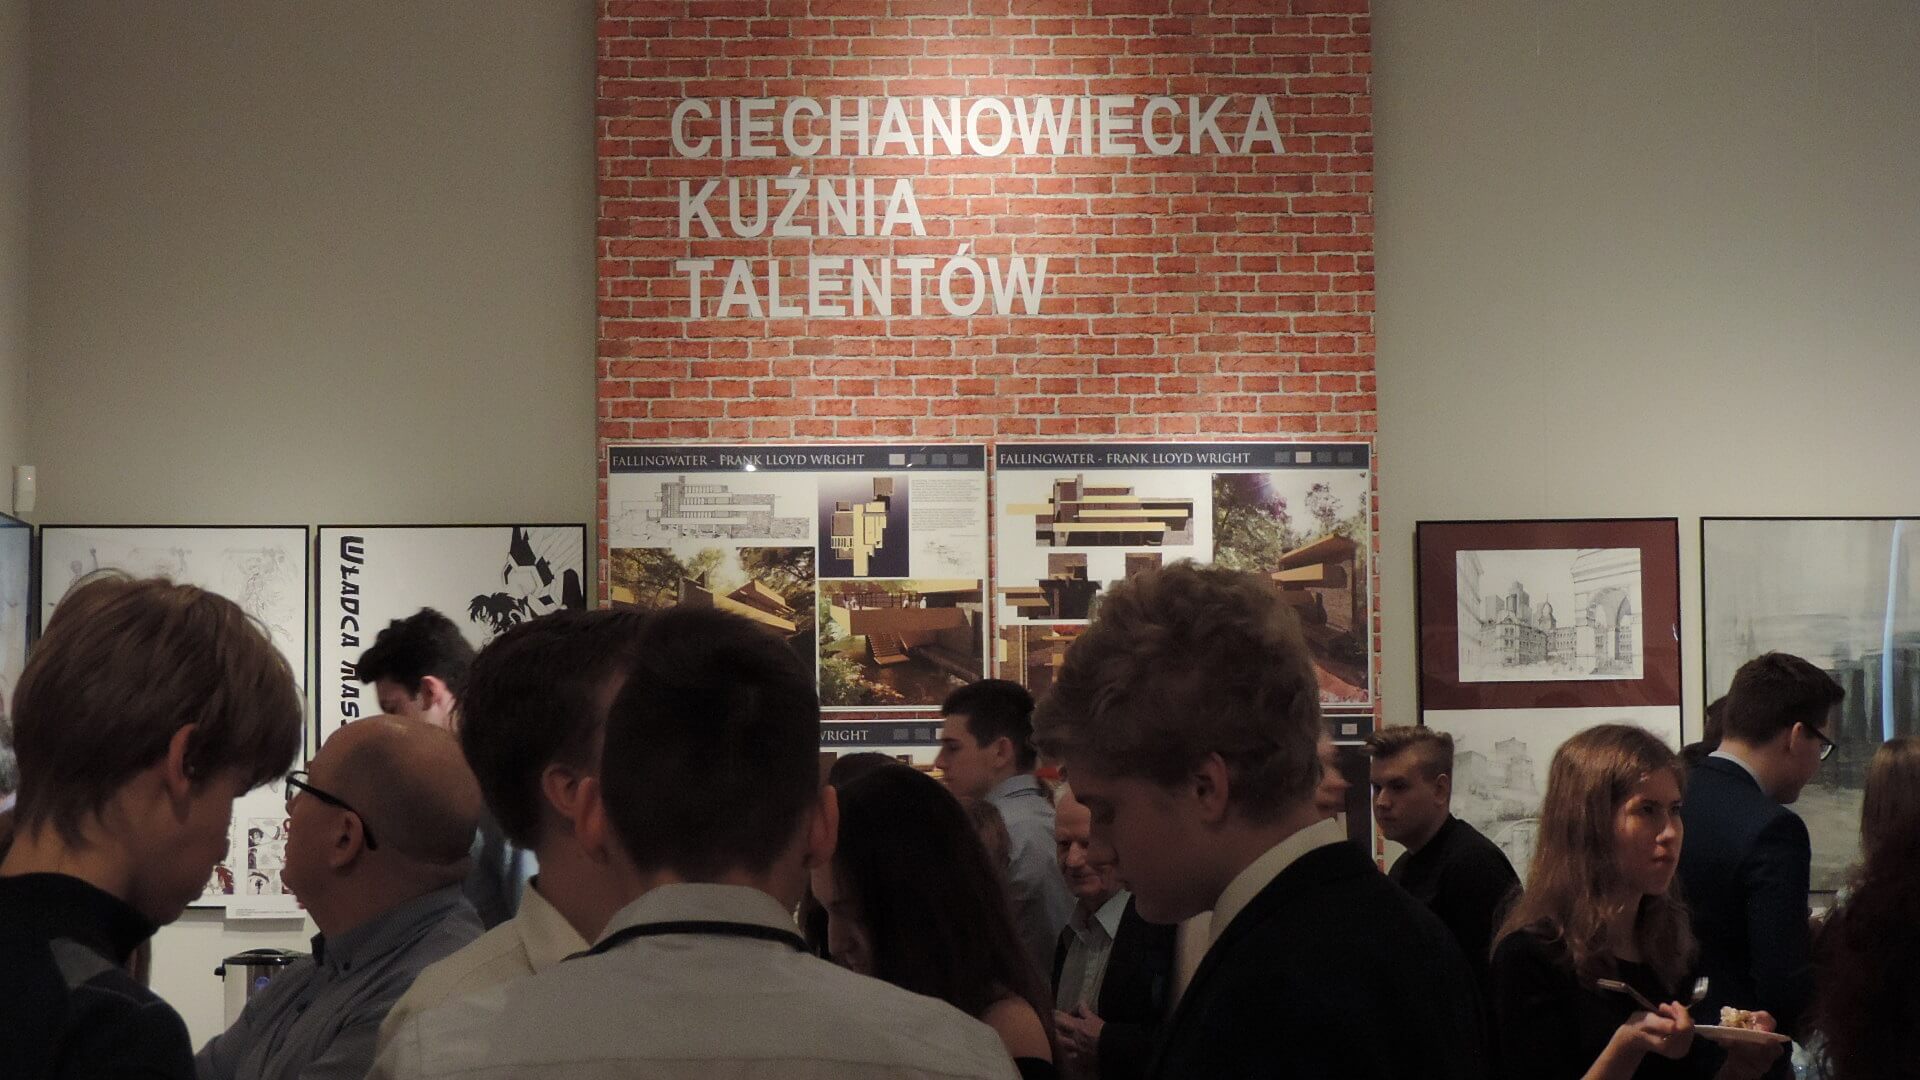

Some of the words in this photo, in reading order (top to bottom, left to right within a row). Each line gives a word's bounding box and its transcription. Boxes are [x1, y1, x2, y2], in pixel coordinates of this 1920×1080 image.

[671, 97, 1285, 158] CIECHANOWIECKA
[678, 167, 927, 239] KUŹNIA
[677, 244, 1049, 318] TALENTÓW
[612, 455, 708, 467] FALLINGWATER
[720, 453, 762, 466] FRANK
[766, 453, 807, 466] LLOYD
[810, 453, 865, 466] WRIGHT
[1000, 453, 1095, 465] FALLINGWATER
[1106, 452, 1150, 464] FRANK
[1153, 451, 1193, 464] LLOYD
[1197, 451, 1251, 464] WRIGHT
[340, 535, 364, 648] WŁADCA
[340, 660, 361, 728] MAS
